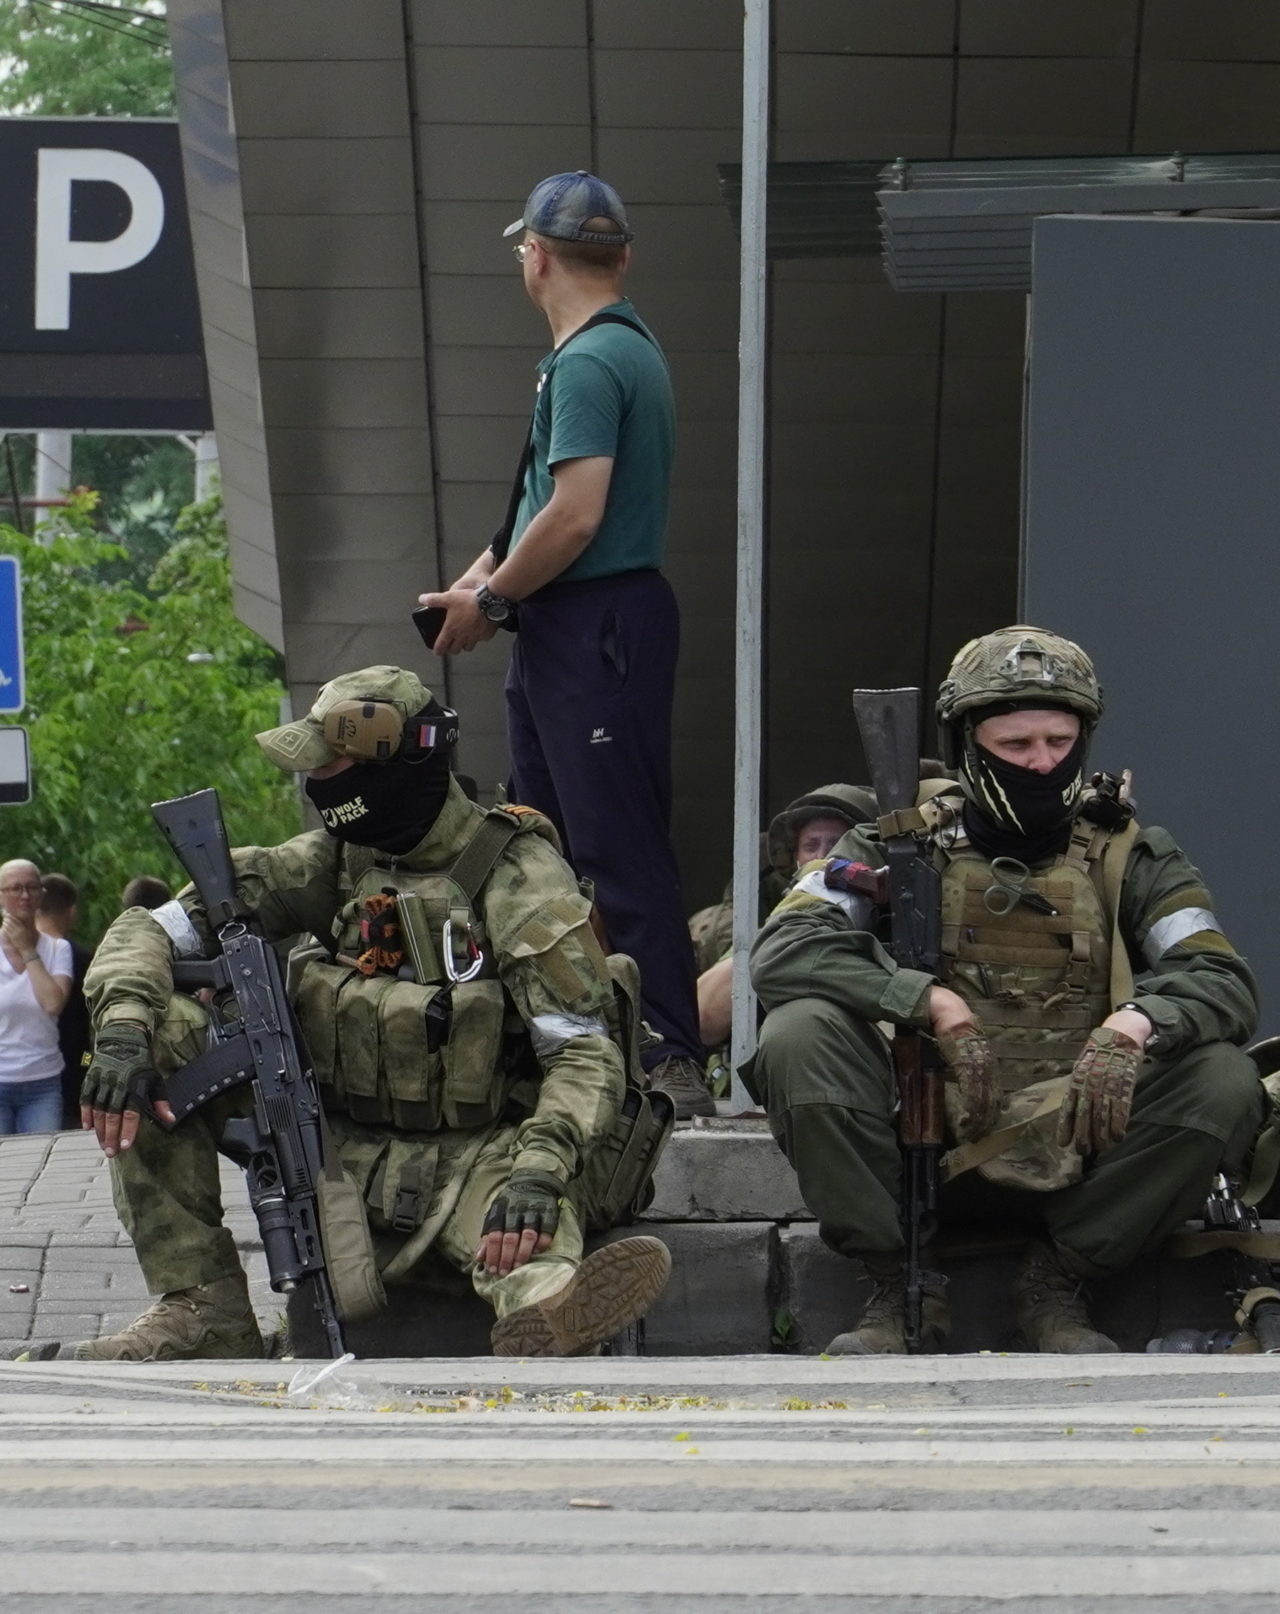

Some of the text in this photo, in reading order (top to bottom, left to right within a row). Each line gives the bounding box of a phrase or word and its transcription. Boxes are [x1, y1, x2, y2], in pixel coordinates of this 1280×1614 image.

[35, 148, 164, 330] P
[334, 796, 363, 815] WOLF
[340, 805, 369, 824] PACK
